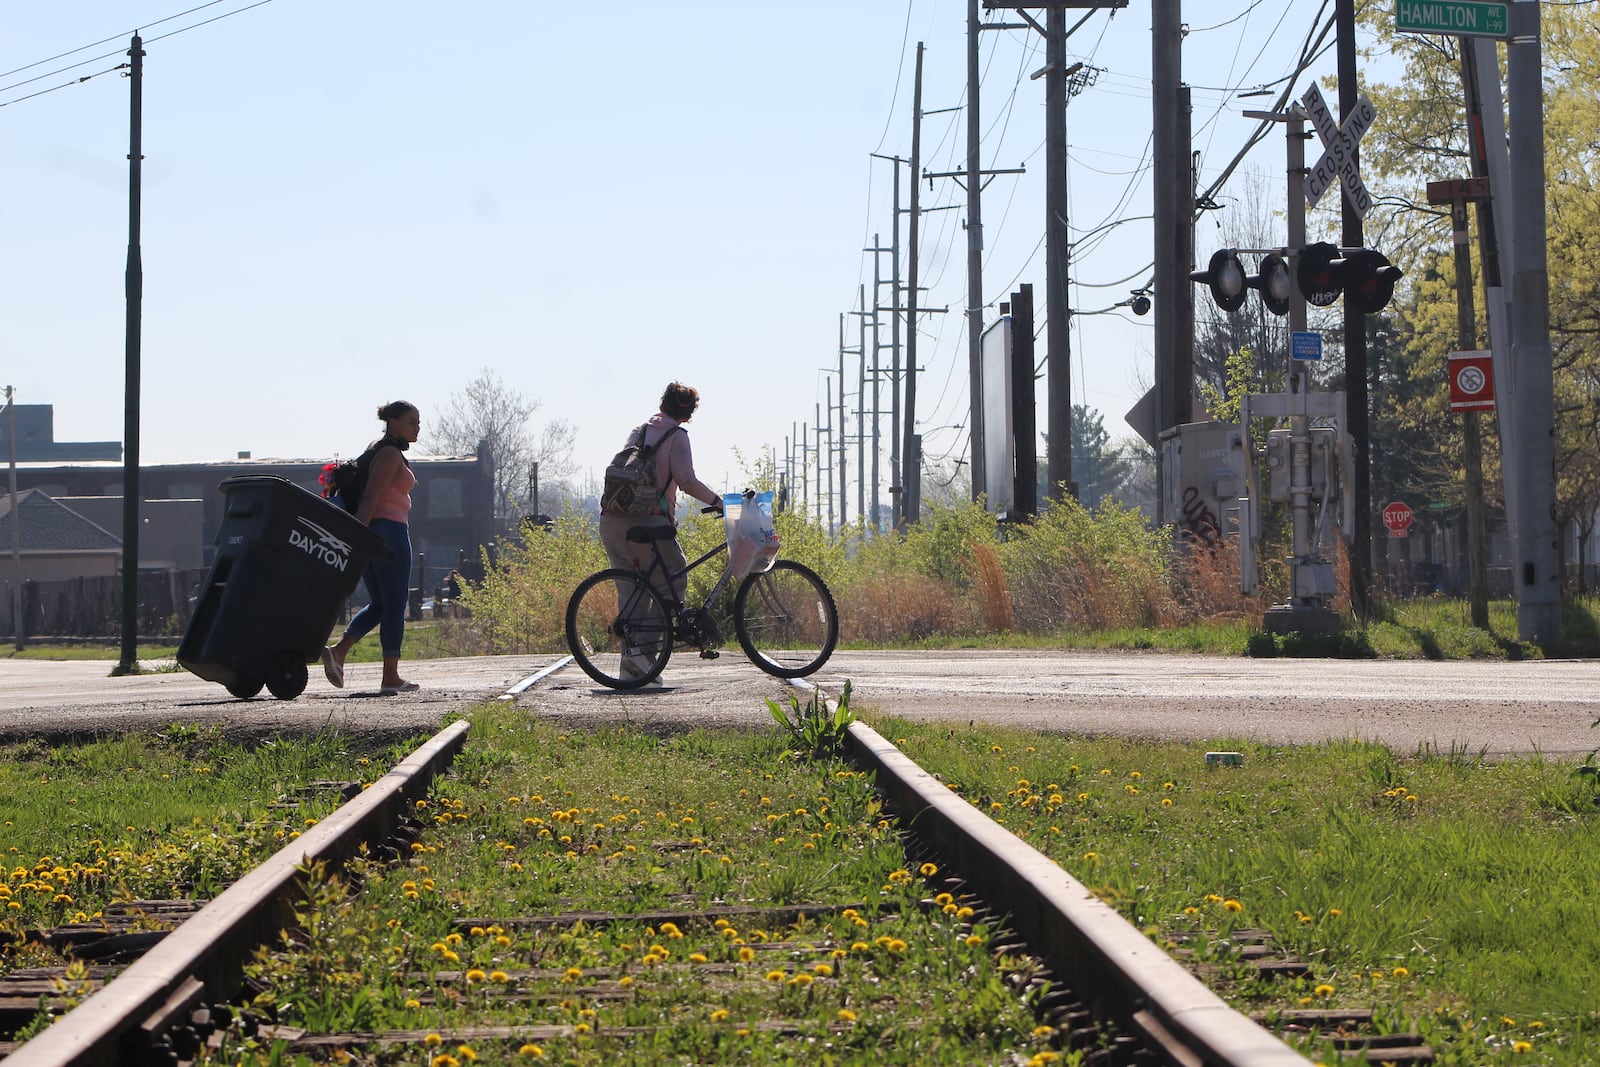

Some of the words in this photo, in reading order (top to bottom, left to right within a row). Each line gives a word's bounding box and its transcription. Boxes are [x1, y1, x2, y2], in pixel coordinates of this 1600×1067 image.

[1400, 2, 1477, 28] HAMILTON
[1487, 7, 1501, 18] AVE
[1486, 20, 1503, 32] 1-99
[1307, 90, 1333, 142] RAIL
[1342, 162, 1368, 210] ROAD
[1309, 104, 1371, 197] CROSSING
[1384, 510, 1410, 523] STOP
[288, 529, 349, 573] DAYTON
